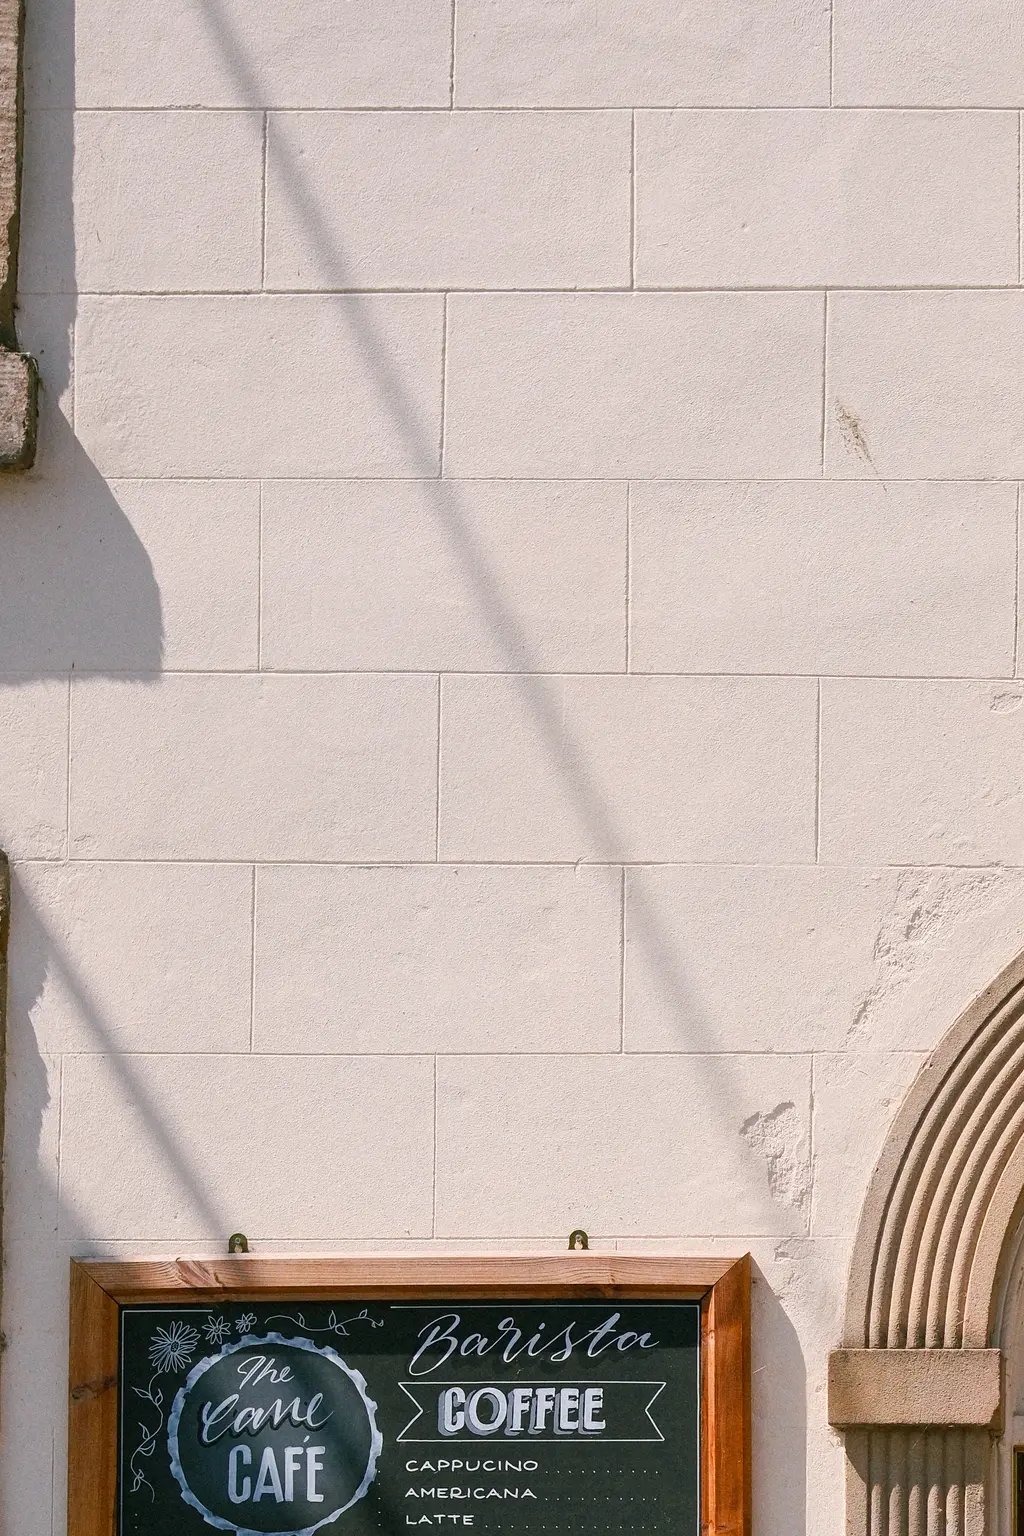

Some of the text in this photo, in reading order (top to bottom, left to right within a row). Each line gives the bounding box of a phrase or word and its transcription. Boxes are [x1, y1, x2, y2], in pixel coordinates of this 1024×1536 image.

[408, 1312, 660, 1376] Barista
[237, 1355, 295, 1390] The
[438, 1386, 606, 1436] COFFEE
[228, 1435, 326, 1504] CAFÉ
[405, 1460, 539, 1473] CAPPUCINO
[405, 1487, 538, 1500] AMERICANA
[405, 1514, 475, 1526] LATTE
